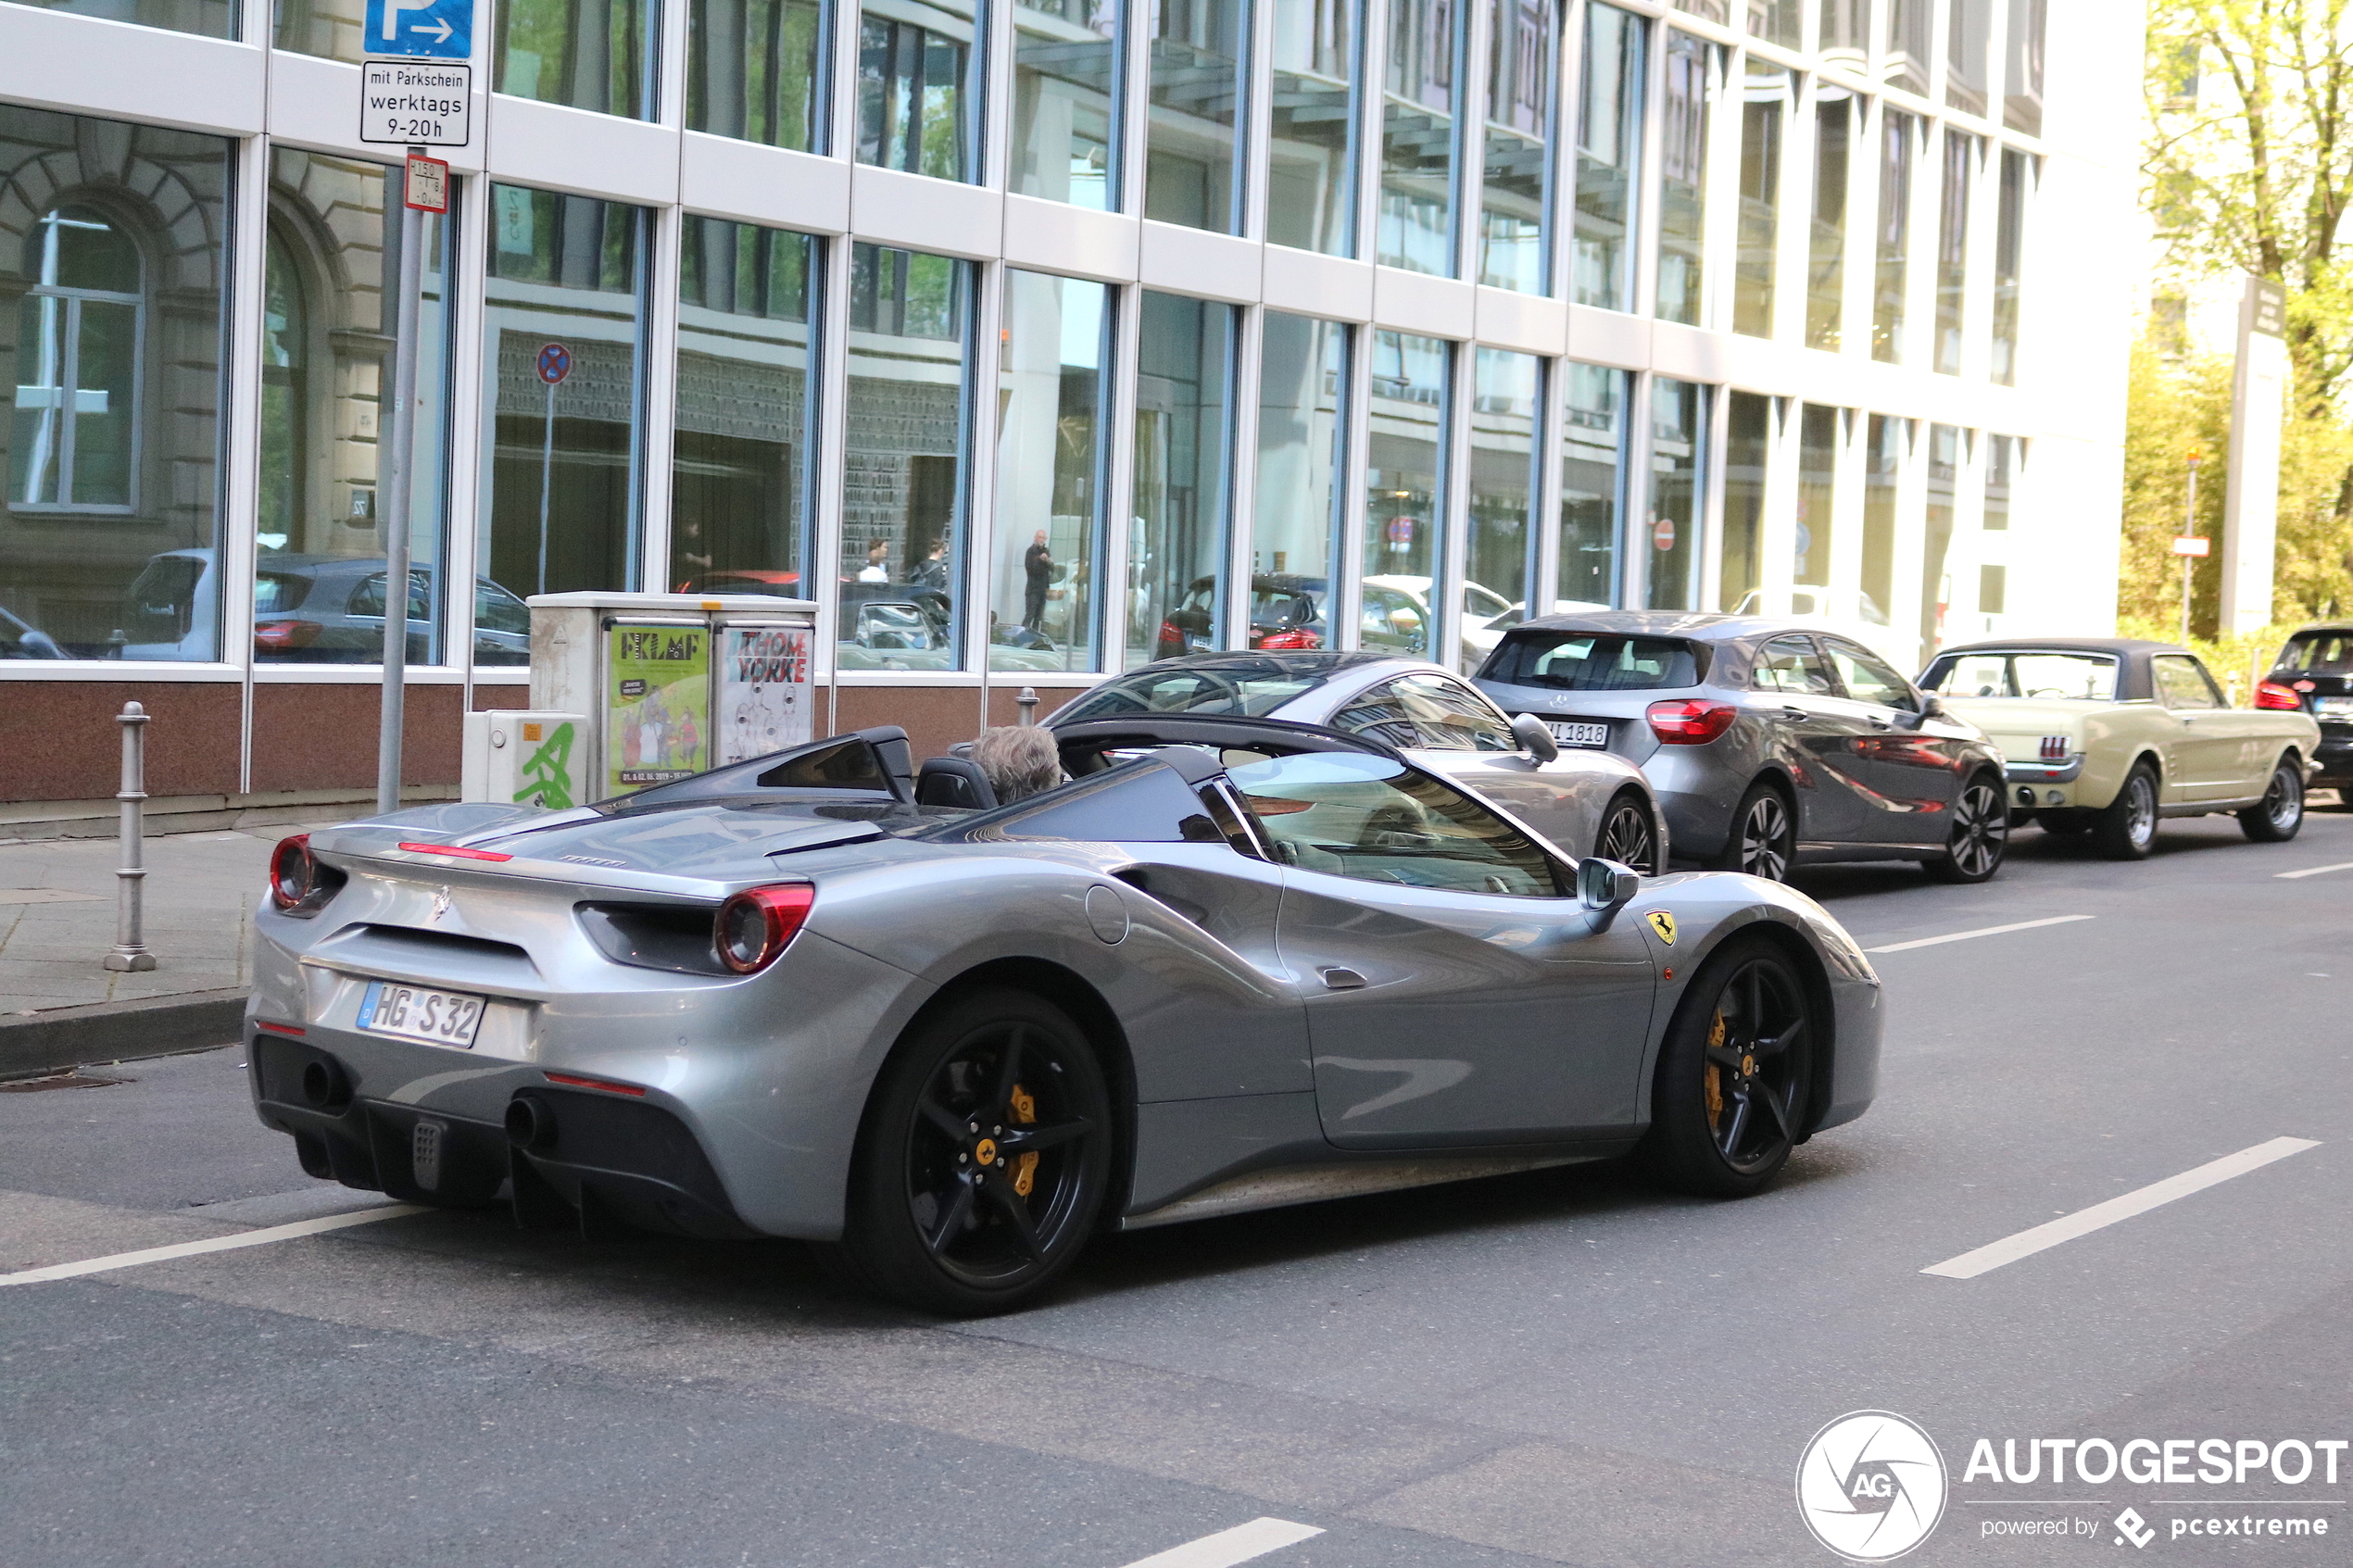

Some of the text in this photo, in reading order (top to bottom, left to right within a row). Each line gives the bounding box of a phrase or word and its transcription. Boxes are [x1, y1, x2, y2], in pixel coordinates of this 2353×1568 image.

[371, 70, 463, 87] mit Parkschein
[371, 94, 461, 116] werktags
[1567, 724, 1604, 742] 1818
[372, 986, 411, 1027] HG
[420, 994, 442, 1032] S
[440, 997, 479, 1039] 32
